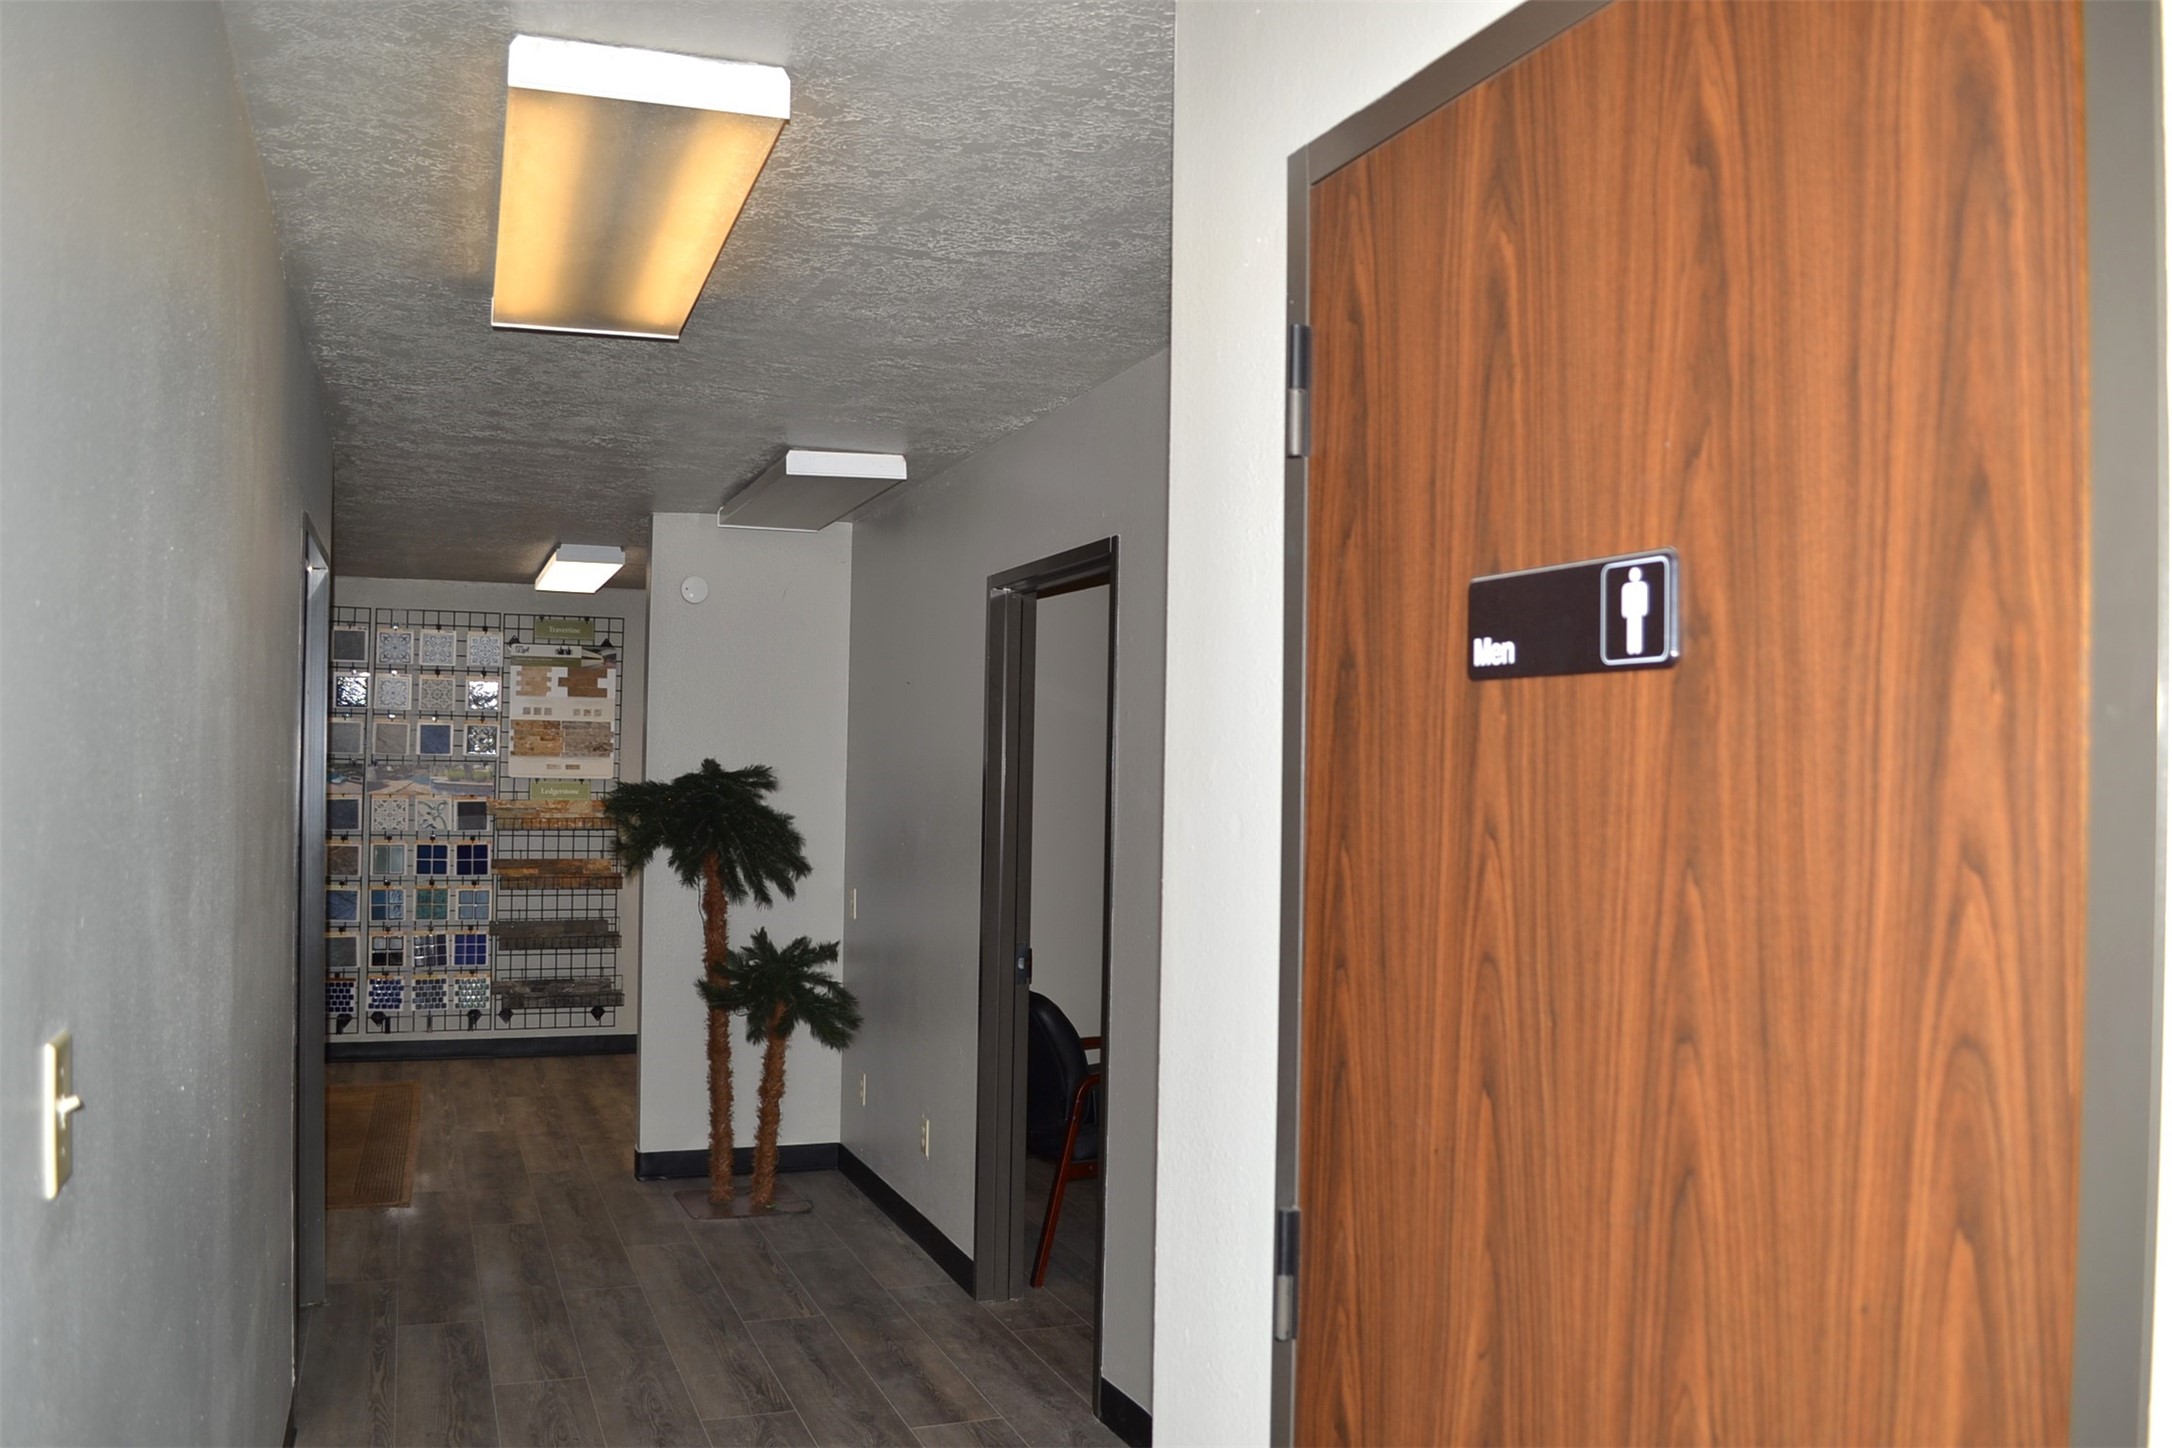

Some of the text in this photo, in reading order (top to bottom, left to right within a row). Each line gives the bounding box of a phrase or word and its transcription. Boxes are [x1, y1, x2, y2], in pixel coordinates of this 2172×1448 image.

[548, 626, 582, 635] Travertine
[1473, 636, 1516, 668] Men
[541, 788, 580, 796] Ledgerstone
